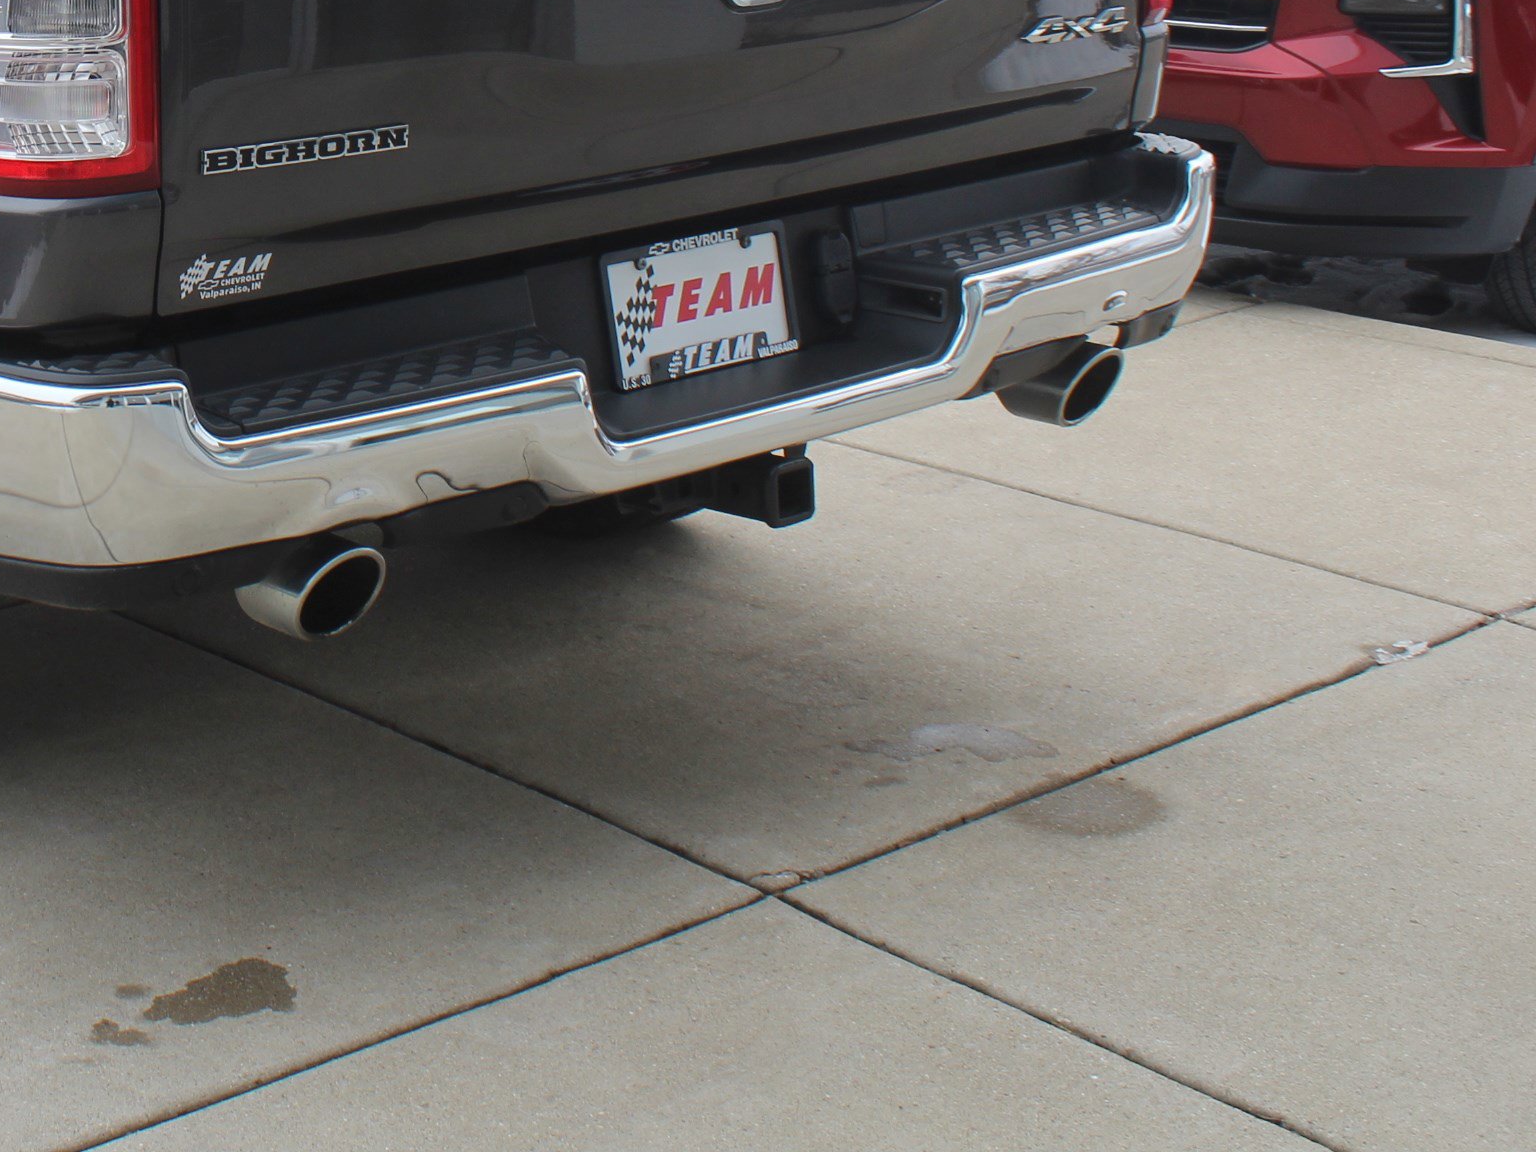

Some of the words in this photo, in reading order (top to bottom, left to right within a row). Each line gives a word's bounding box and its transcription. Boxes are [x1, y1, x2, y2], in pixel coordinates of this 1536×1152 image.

[201, 124, 409, 176] BIGHORN
[672, 228, 738, 252] CHEVROLET
[200, 252, 273, 281] TEAM
[199, 285, 251, 300] Valparaiso,
[251, 281, 262, 291] IN
[220, 272, 265, 286] CHEVROLET
[651, 262, 775, 329] TEAM
[683, 332, 755, 370] TEAM
[757, 339, 799, 358] VALPARAISO
[622, 377, 639, 391] U.S.
[640, 374, 652, 386] 30
